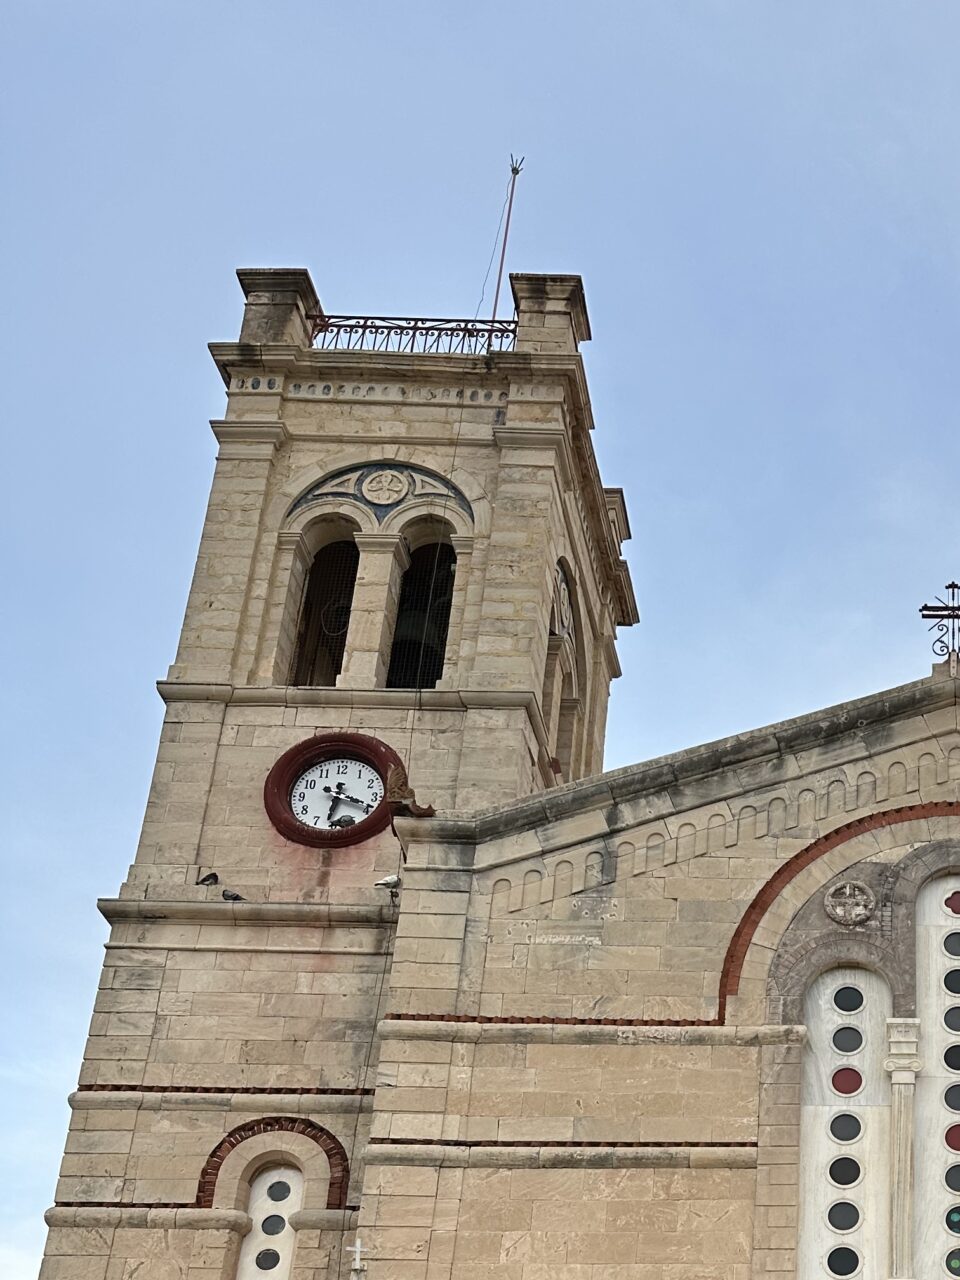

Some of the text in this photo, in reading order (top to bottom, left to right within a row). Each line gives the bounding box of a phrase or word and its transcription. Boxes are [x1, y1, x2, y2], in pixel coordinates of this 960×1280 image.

[319, 769, 329, 778] 11
[336, 765, 348, 775] 12
[358, 769, 362, 779] 1
[305, 779, 316, 789] 10
[367, 779, 374, 789] 2
[298, 792, 305, 802] 9
[371, 792, 378, 802] 3
[301, 805, 308, 815] 8
[313, 816, 320, 826] 7
